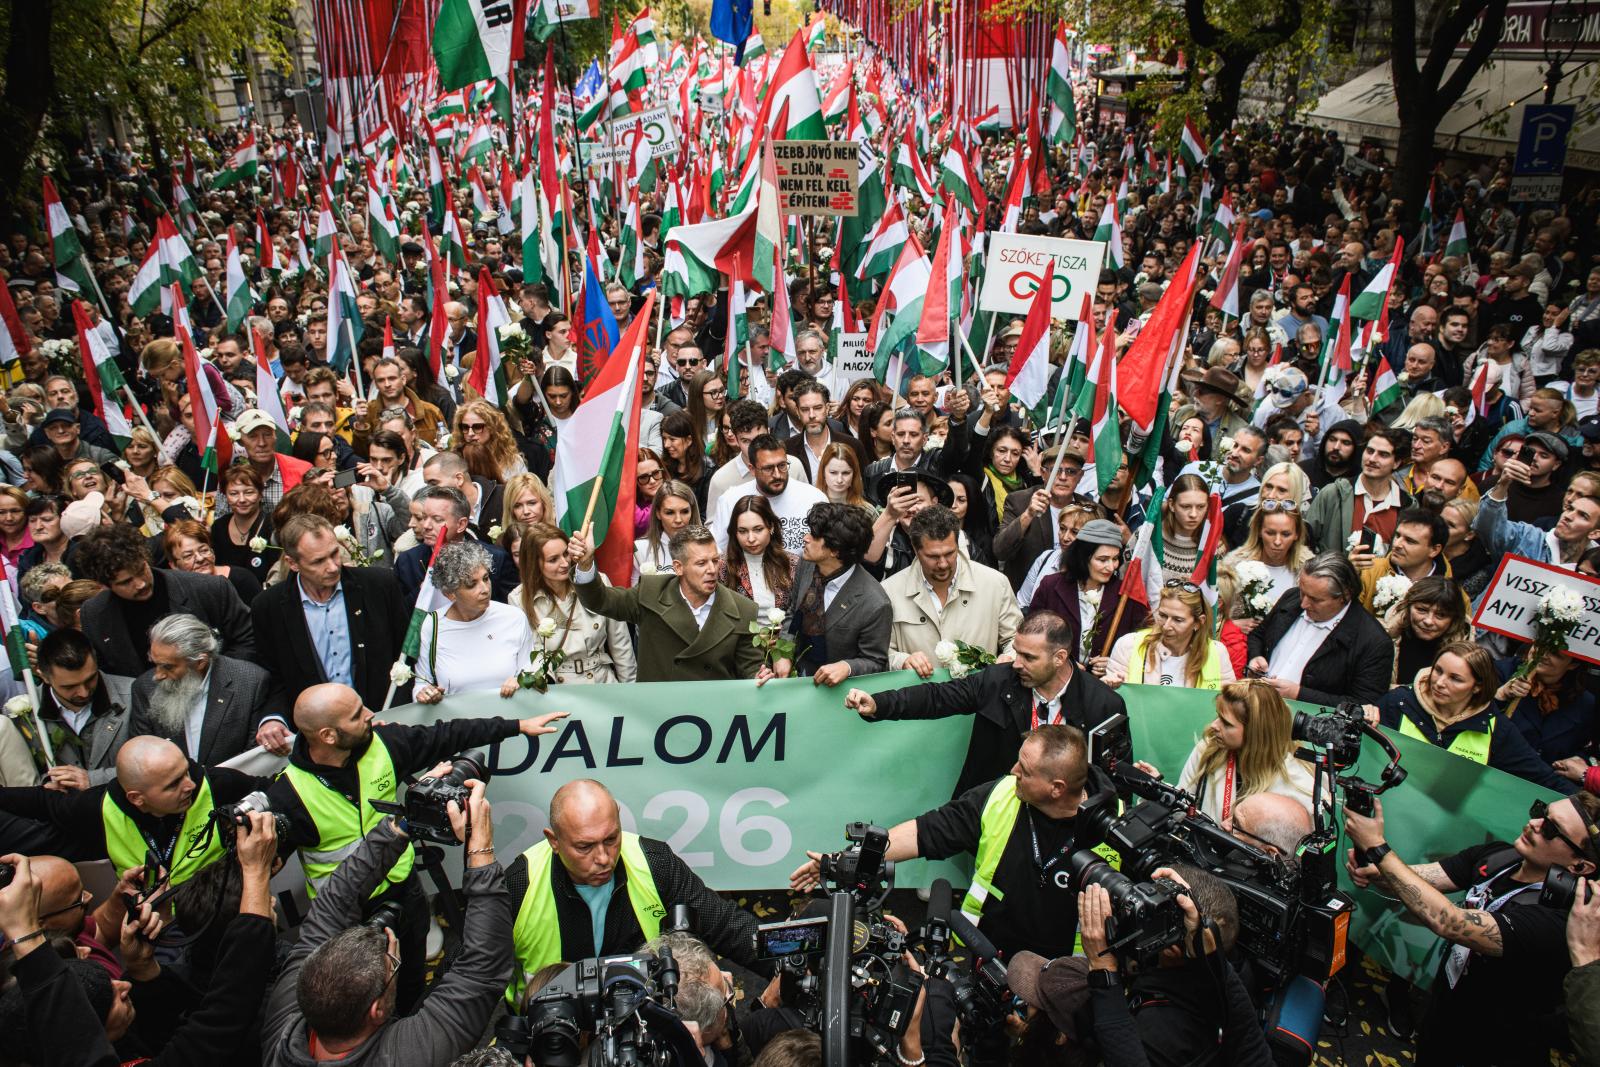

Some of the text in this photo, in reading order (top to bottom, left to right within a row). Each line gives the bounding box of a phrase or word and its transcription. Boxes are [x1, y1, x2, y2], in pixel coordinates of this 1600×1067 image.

[1534, 123, 1557, 152] P
[806, 143, 831, 159] JÖVŐ
[834, 147, 857, 160] NEM
[791, 161, 826, 177] ELJÖN,
[778, 179, 851, 192] NEM FEL KELL
[1000, 248, 1087, 271] SZŐKE TISZA
[842, 338, 867, 347] MILLIÓ
[1487, 599, 1525, 621] AMI
[493, 787, 792, 868] 226
